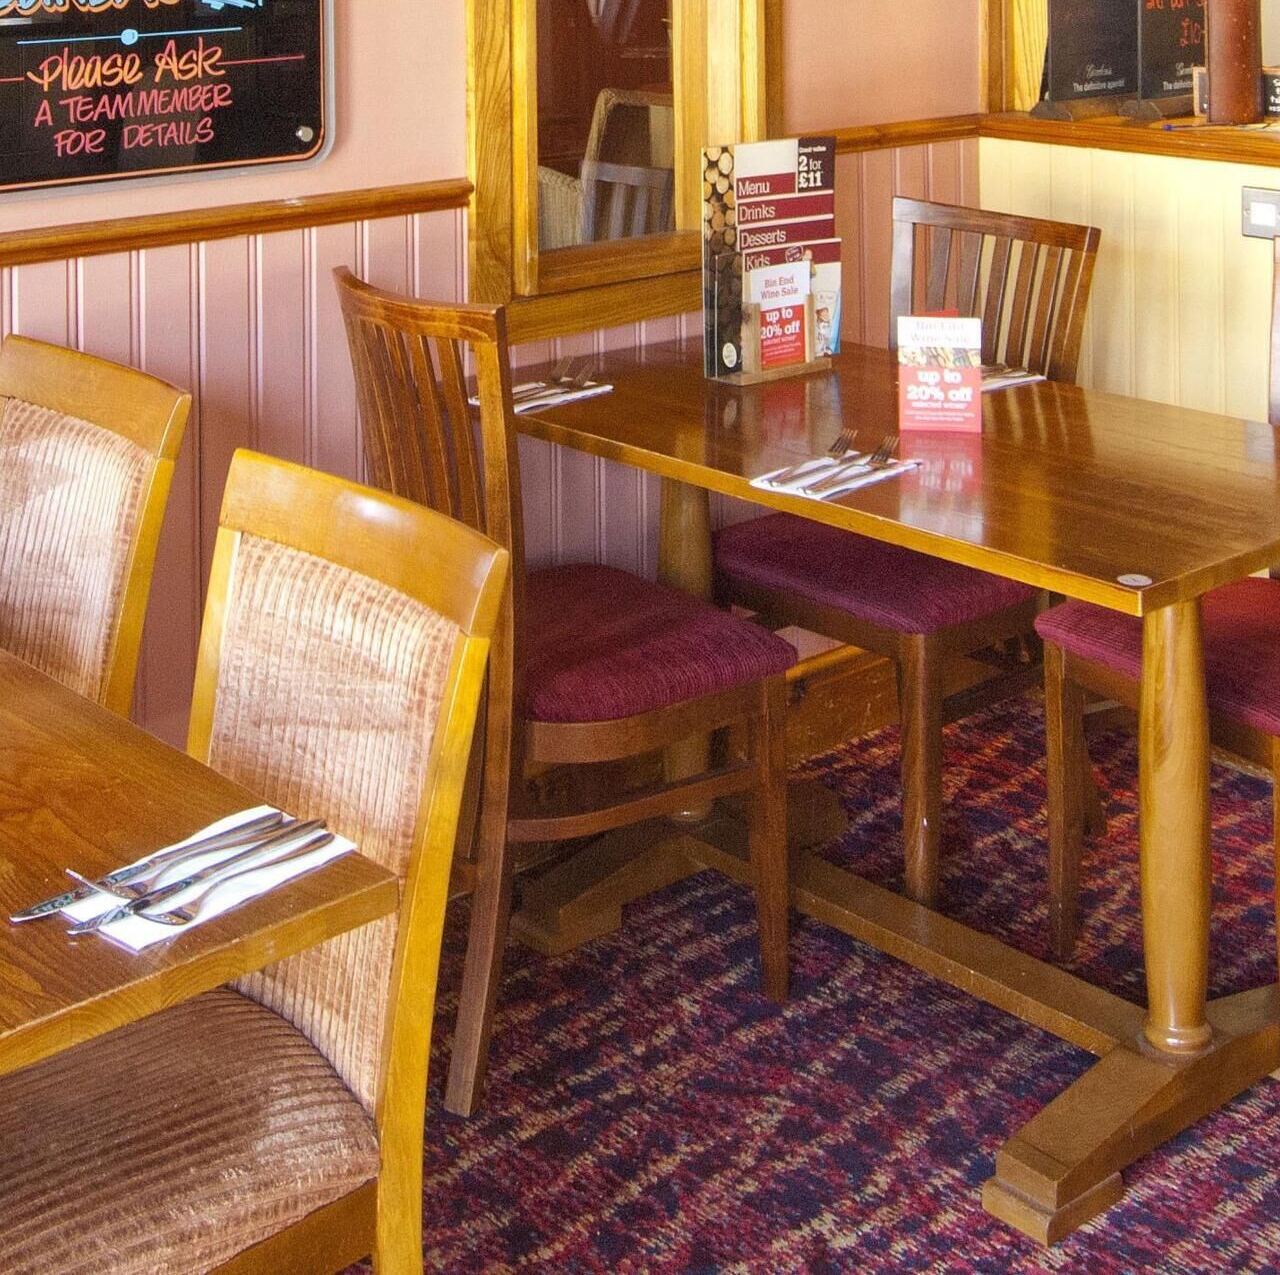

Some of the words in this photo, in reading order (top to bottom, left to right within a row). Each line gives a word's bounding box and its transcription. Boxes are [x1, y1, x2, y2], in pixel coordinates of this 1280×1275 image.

[26, 47, 143, 92] Please
[154, 37, 225, 82] Ask
[34, 99, 53, 127] A
[53, 129, 106, 157] FOR
[123, 117, 214, 149] DETAILS
[799, 156, 808, 171] 2
[809, 159, 821, 169] for
[738, 180, 770, 196] Menu
[739, 204, 776, 221] Drinks
[741, 229, 787, 248] Desserts
[746, 254, 771, 271] Kids
[764, 278, 778, 288] Bin
[779, 275, 794, 285] End
[761, 289, 780, 299] Wine
[781, 286, 798, 296] Sale
[766, 311, 779, 323] up
[782, 308, 793, 319] to
[760, 325, 782, 340] 20%
[784, 320, 800, 334] off
[917, 371, 940, 385] up
[943, 368, 962, 384] to
[906, 385, 944, 401] 20%
